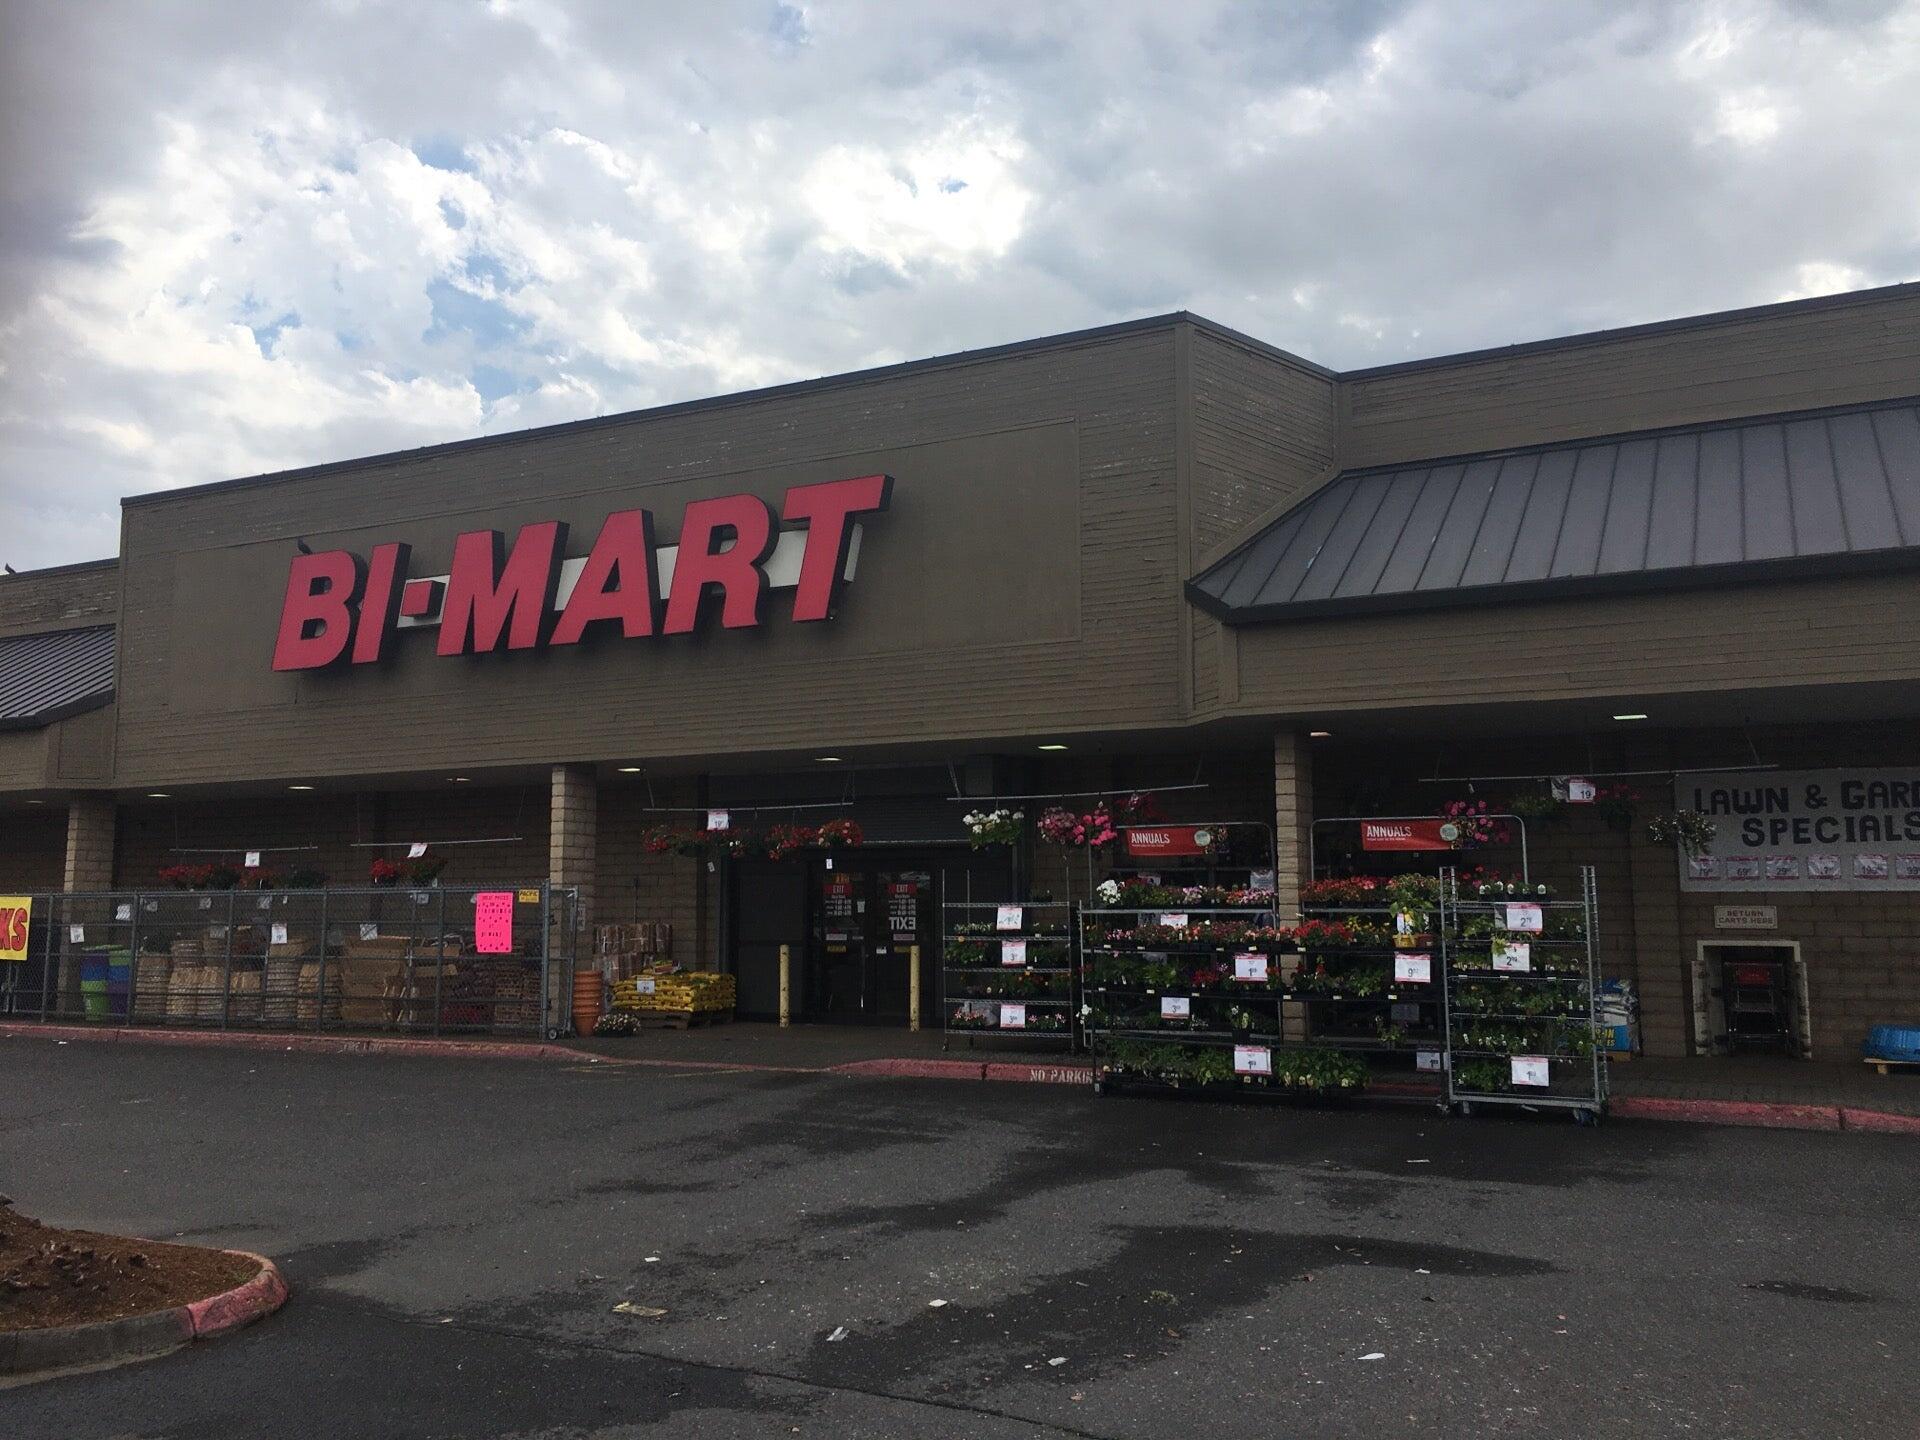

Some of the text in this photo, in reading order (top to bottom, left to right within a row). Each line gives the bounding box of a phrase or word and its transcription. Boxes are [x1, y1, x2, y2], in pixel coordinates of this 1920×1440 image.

[272, 474, 895, 671] BI-MART
[1694, 786, 1790, 816] LAWN
[1804, 784, 1828, 810] &
[1131, 832, 1171, 845] ANNUALS
[1367, 825, 1413, 838] ANNUALS
[1741, 811, 1920, 847] SPECIALS
[1030, 1069, 1046, 1082] NO
